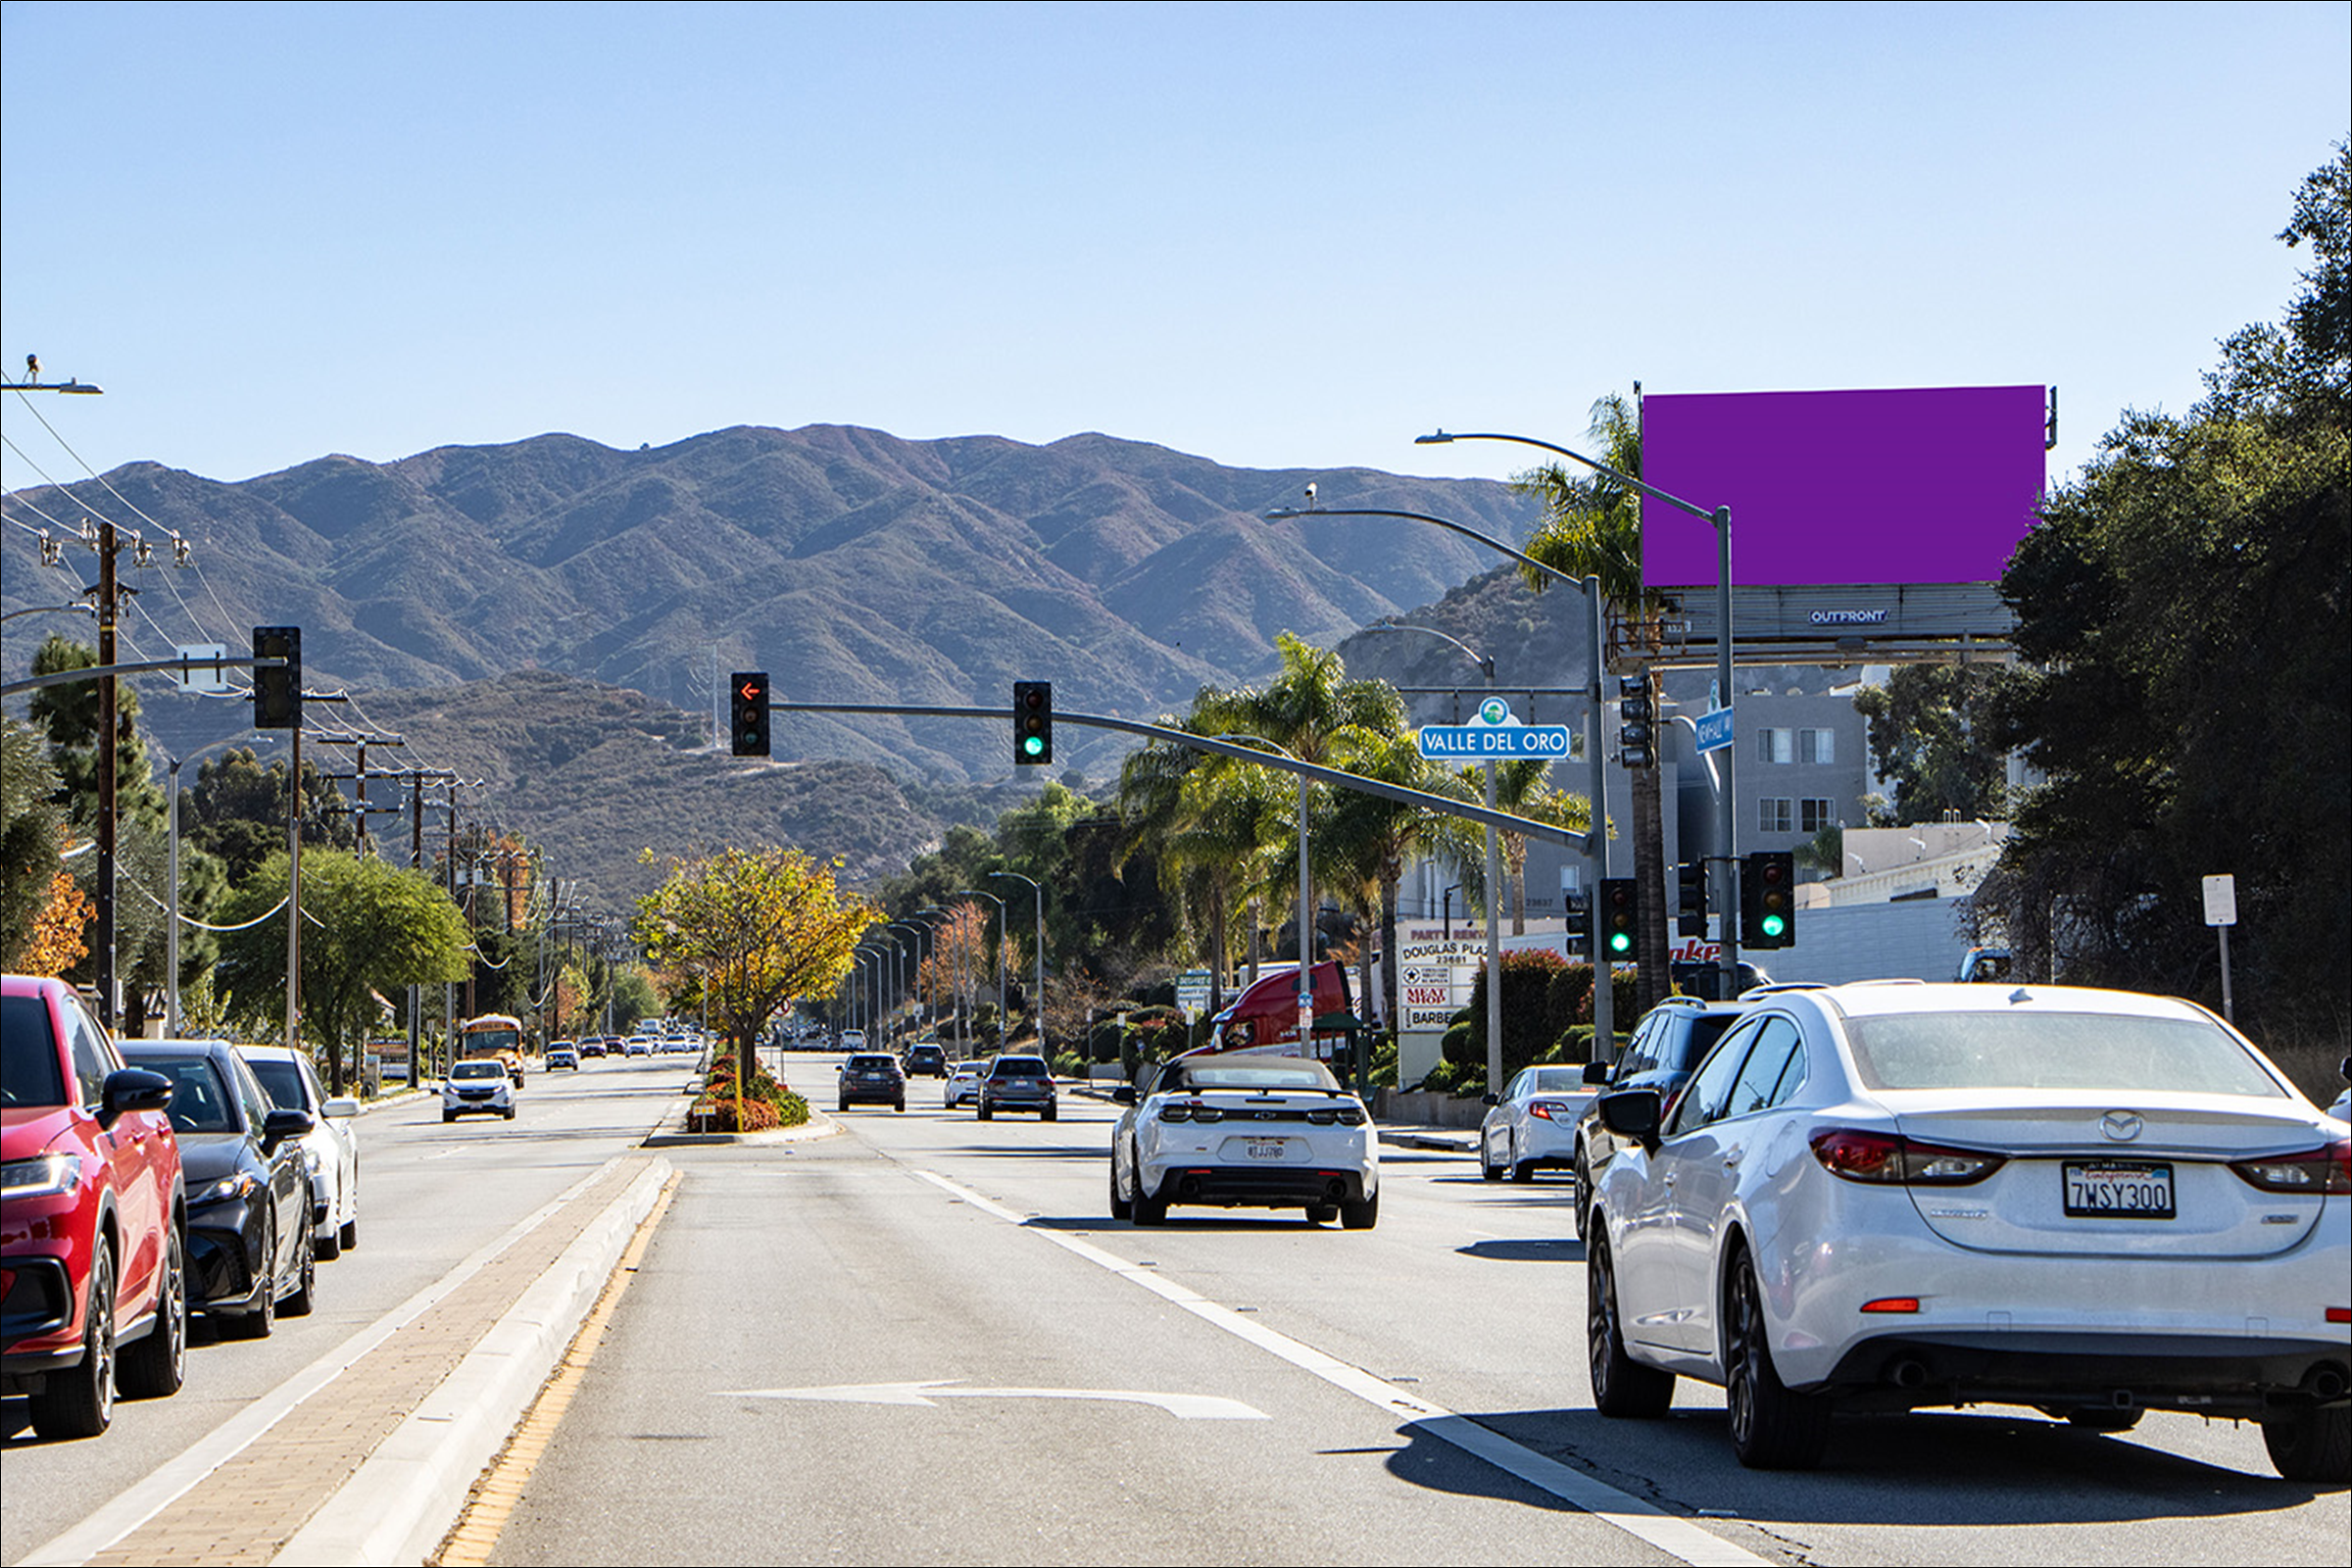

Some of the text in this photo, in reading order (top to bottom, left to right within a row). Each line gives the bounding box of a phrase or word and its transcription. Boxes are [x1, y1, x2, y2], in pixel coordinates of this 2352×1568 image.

[1811, 611, 1886, 623] OUTFRONT
[1424, 732, 1565, 752] VALLE DEL ORO
[1402, 943, 1457, 959] DOUGLAS
[1407, 996, 1446, 1004] SHOP
[2071, 1182, 2167, 1209] 7WSY300
